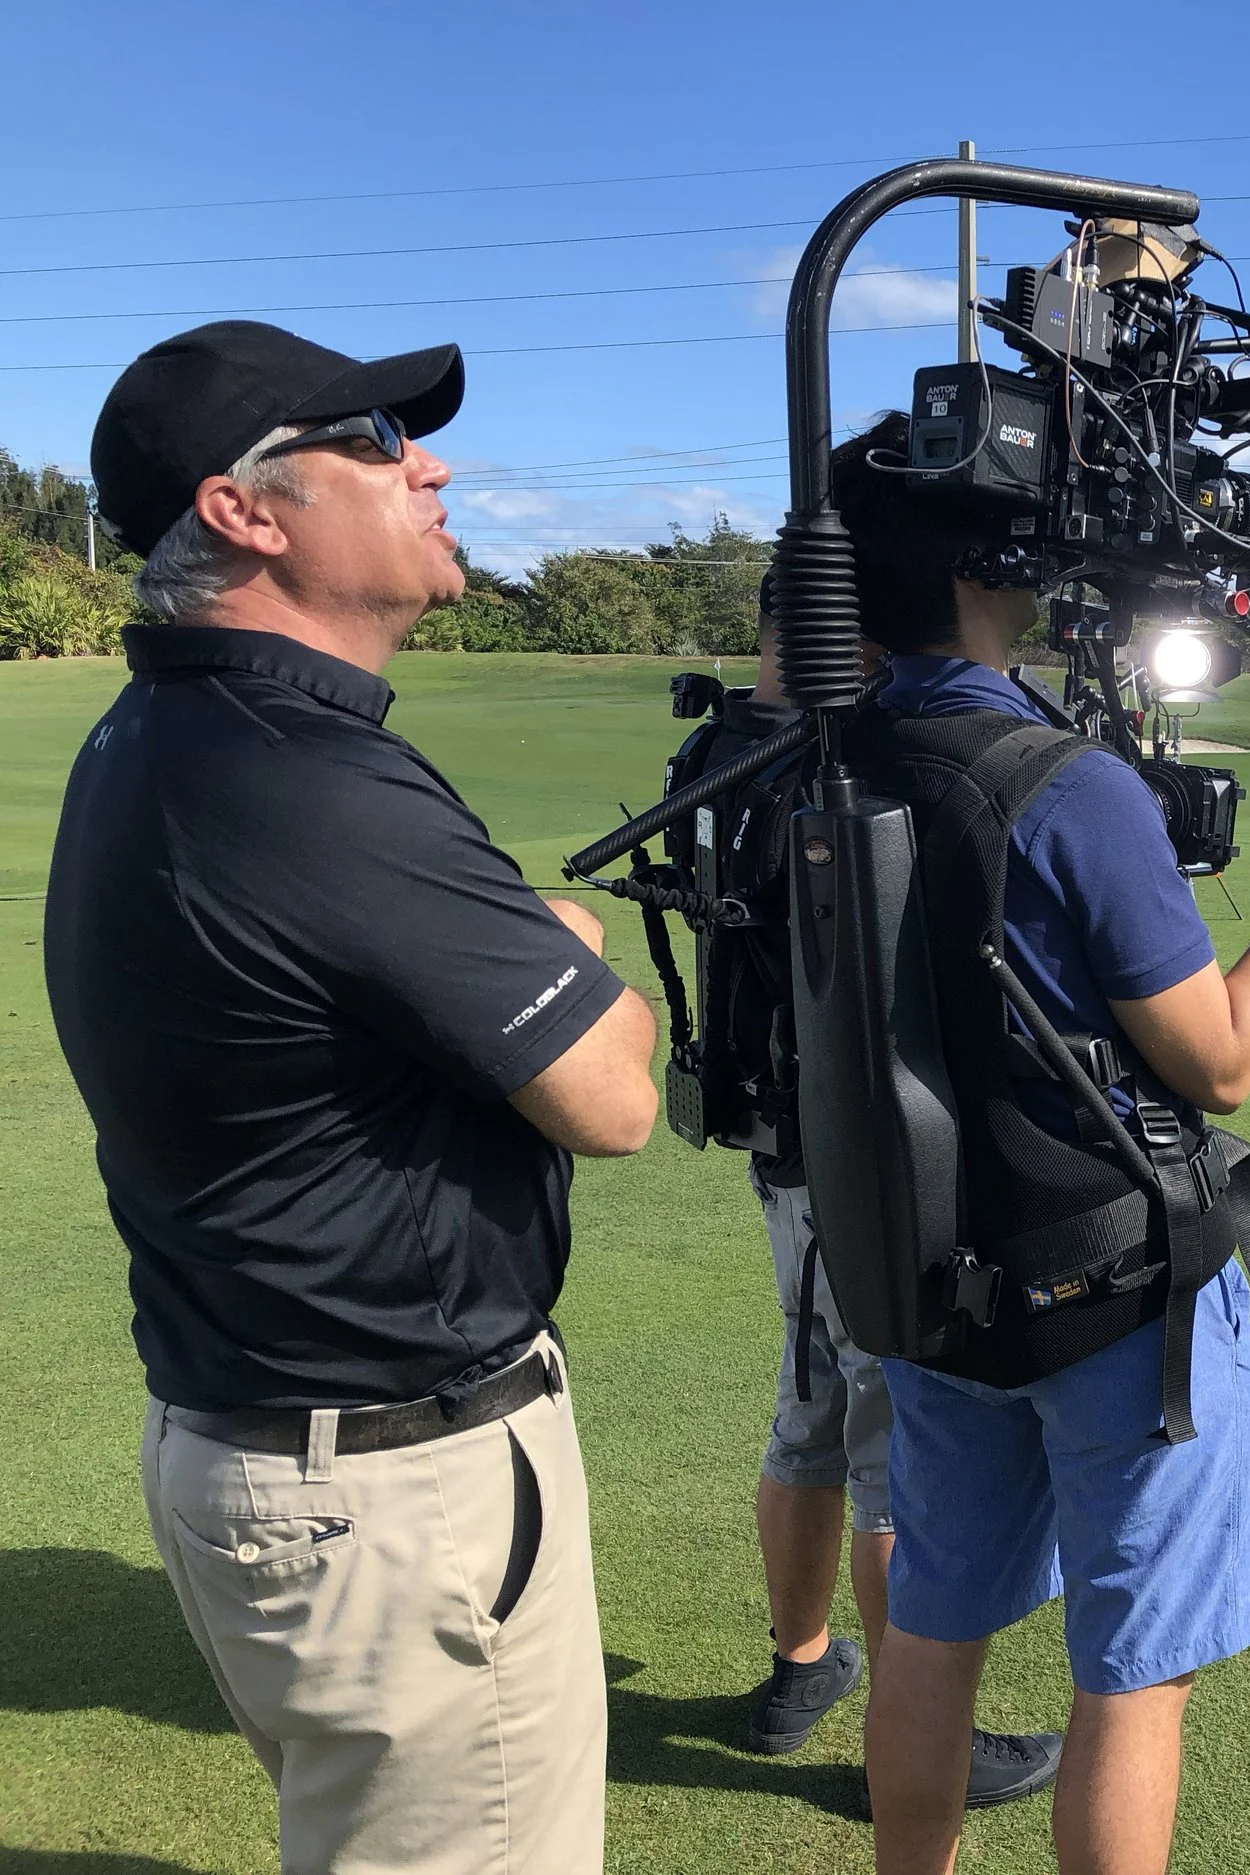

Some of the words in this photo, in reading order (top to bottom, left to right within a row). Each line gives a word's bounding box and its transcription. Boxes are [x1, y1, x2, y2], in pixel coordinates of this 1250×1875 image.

[927, 385, 957, 394] ANTON
[926, 392, 957, 402] BAUER
[935, 405, 946, 413] 10
[1000, 424, 1035, 440] ANTON
[1000, 433, 1034, 449] BAUER
[733, 808, 751, 851] RIG
[1053, 1282, 1072, 1295] Made
[1056, 1286, 1081, 1300] Sweden
